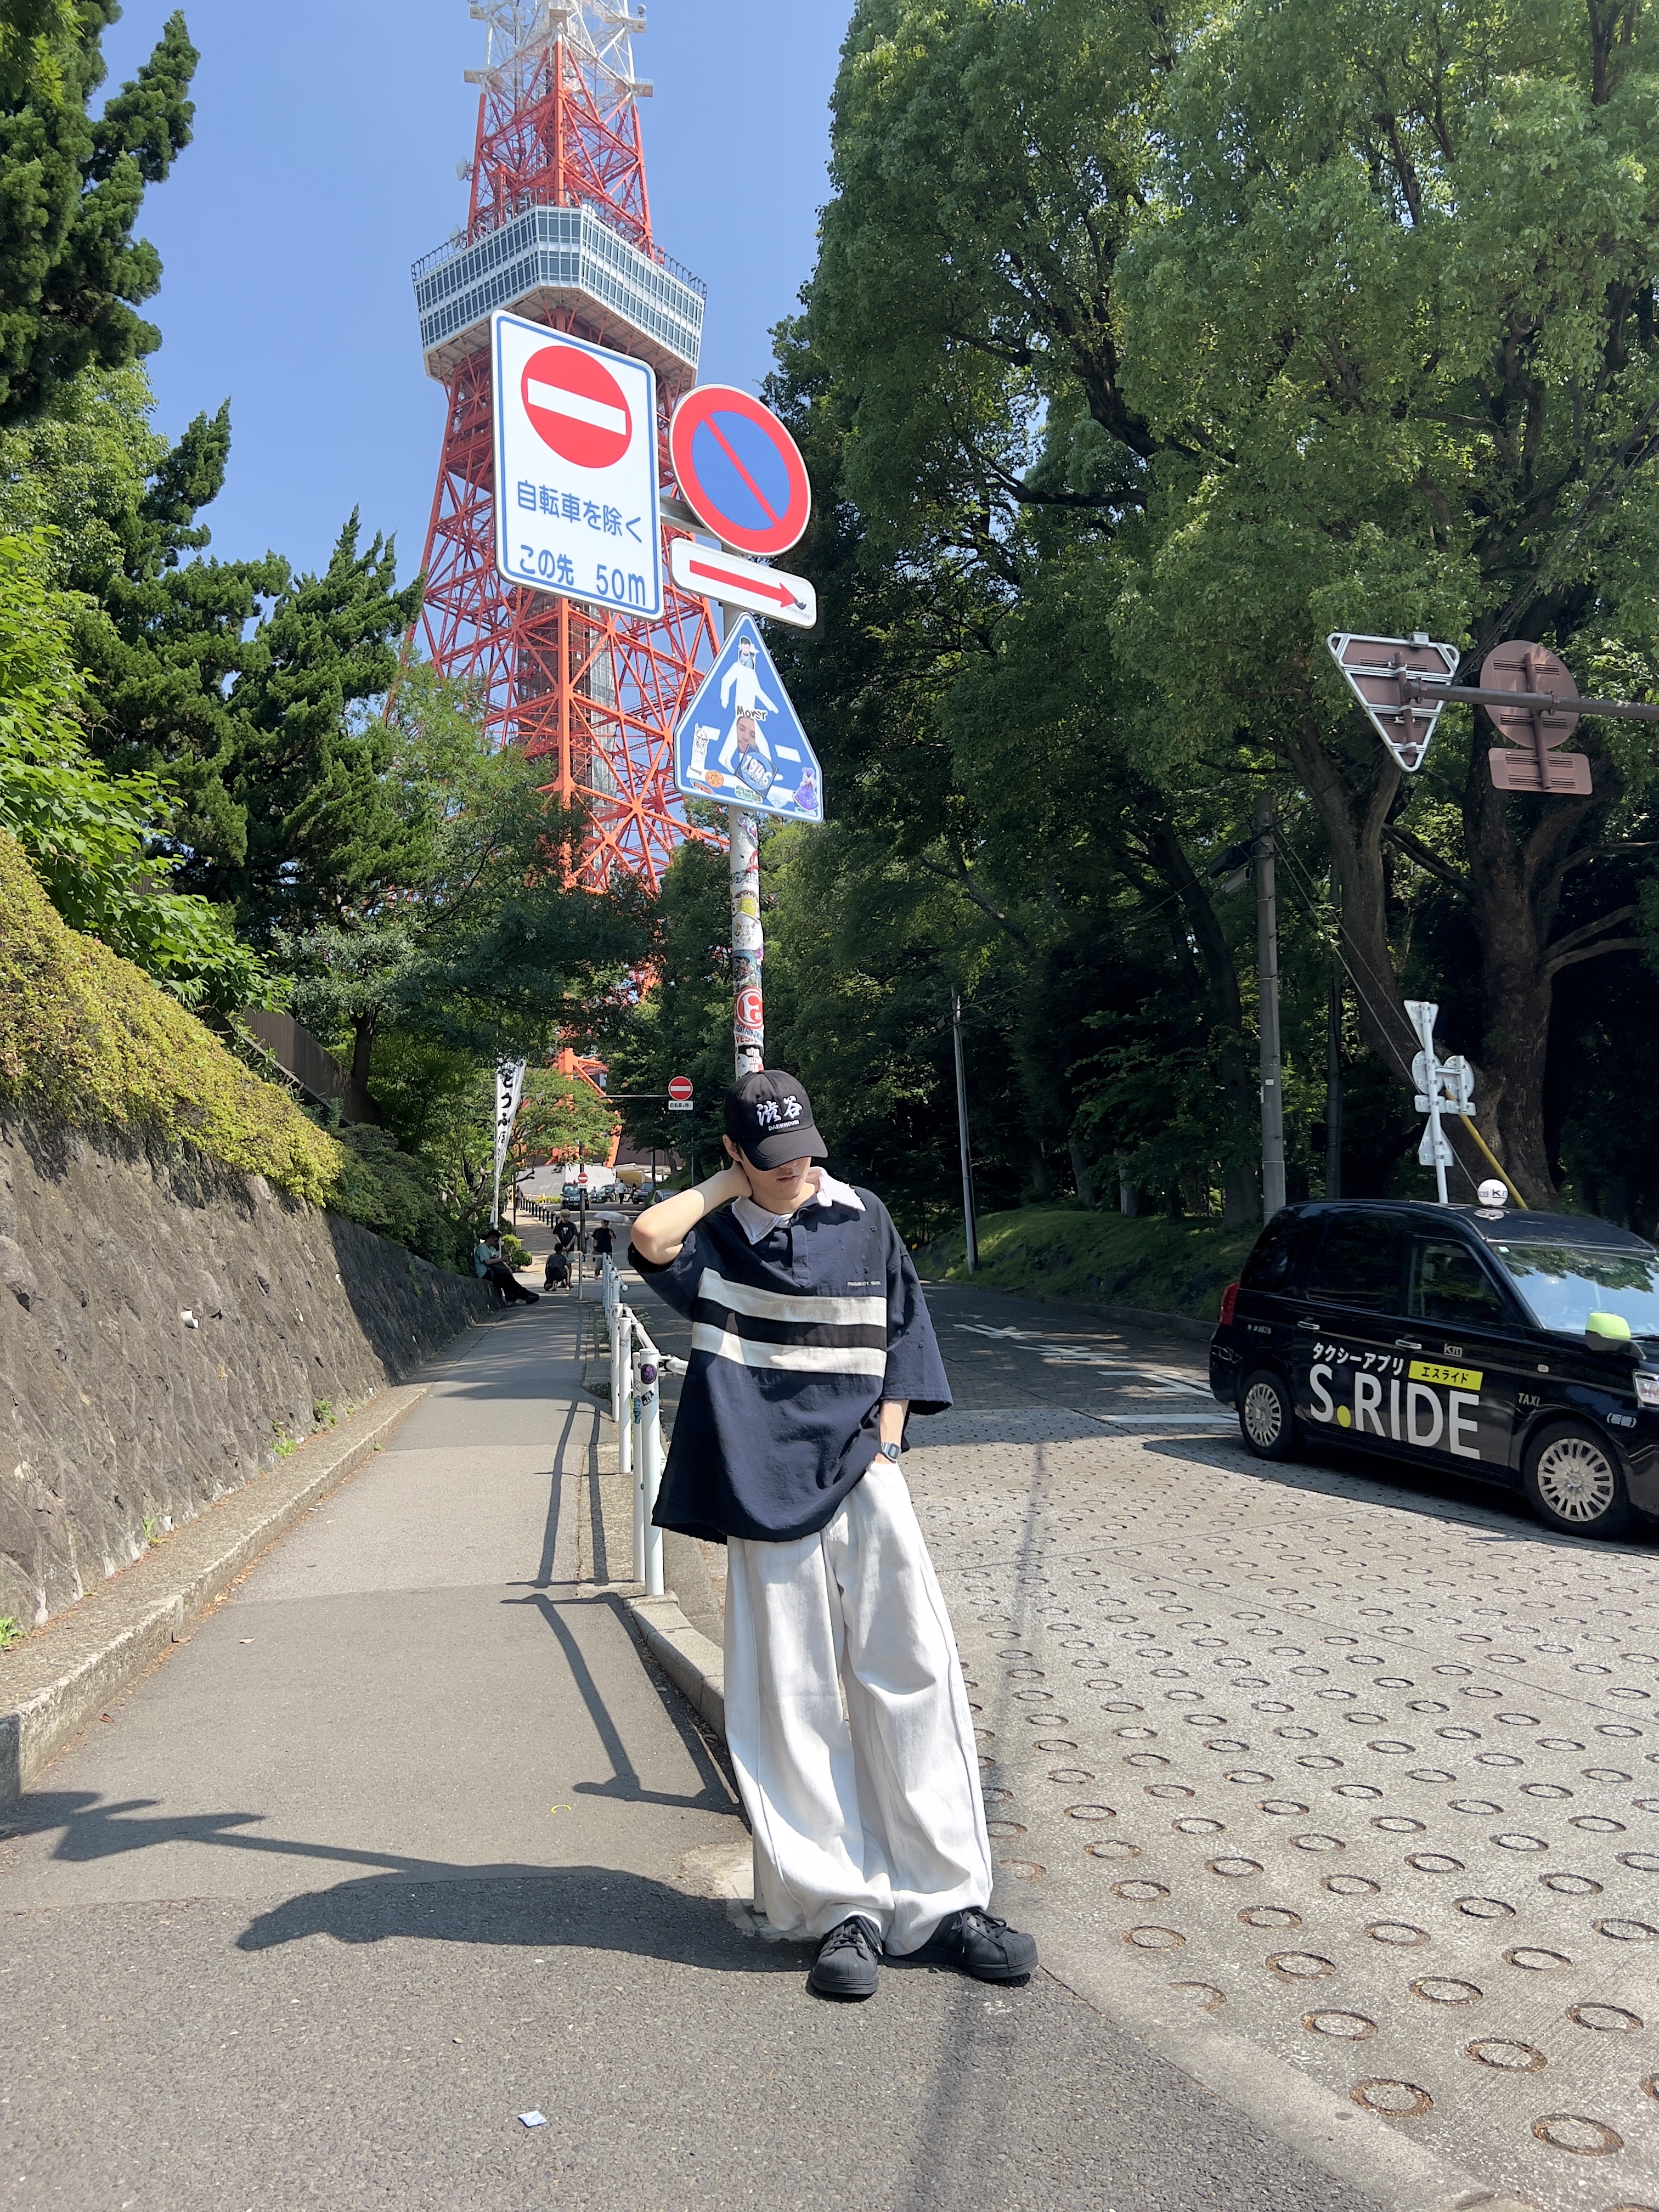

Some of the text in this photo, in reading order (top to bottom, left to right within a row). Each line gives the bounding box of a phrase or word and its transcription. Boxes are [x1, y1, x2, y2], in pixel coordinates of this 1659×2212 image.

[517, 479, 642, 543] 自転車を除く
[520, 544, 646, 606] この先 50m
[743, 754, 772, 786] 1946
[756, 1095, 803, 1126] 渋谷
[1313, 1342, 1404, 1376] タクシーアプリ
[1421, 1366, 1469, 1384] エスライド
[1310, 1363, 1481, 1460] S.RIDE
[1518, 1392, 1541, 1406] TAXI
